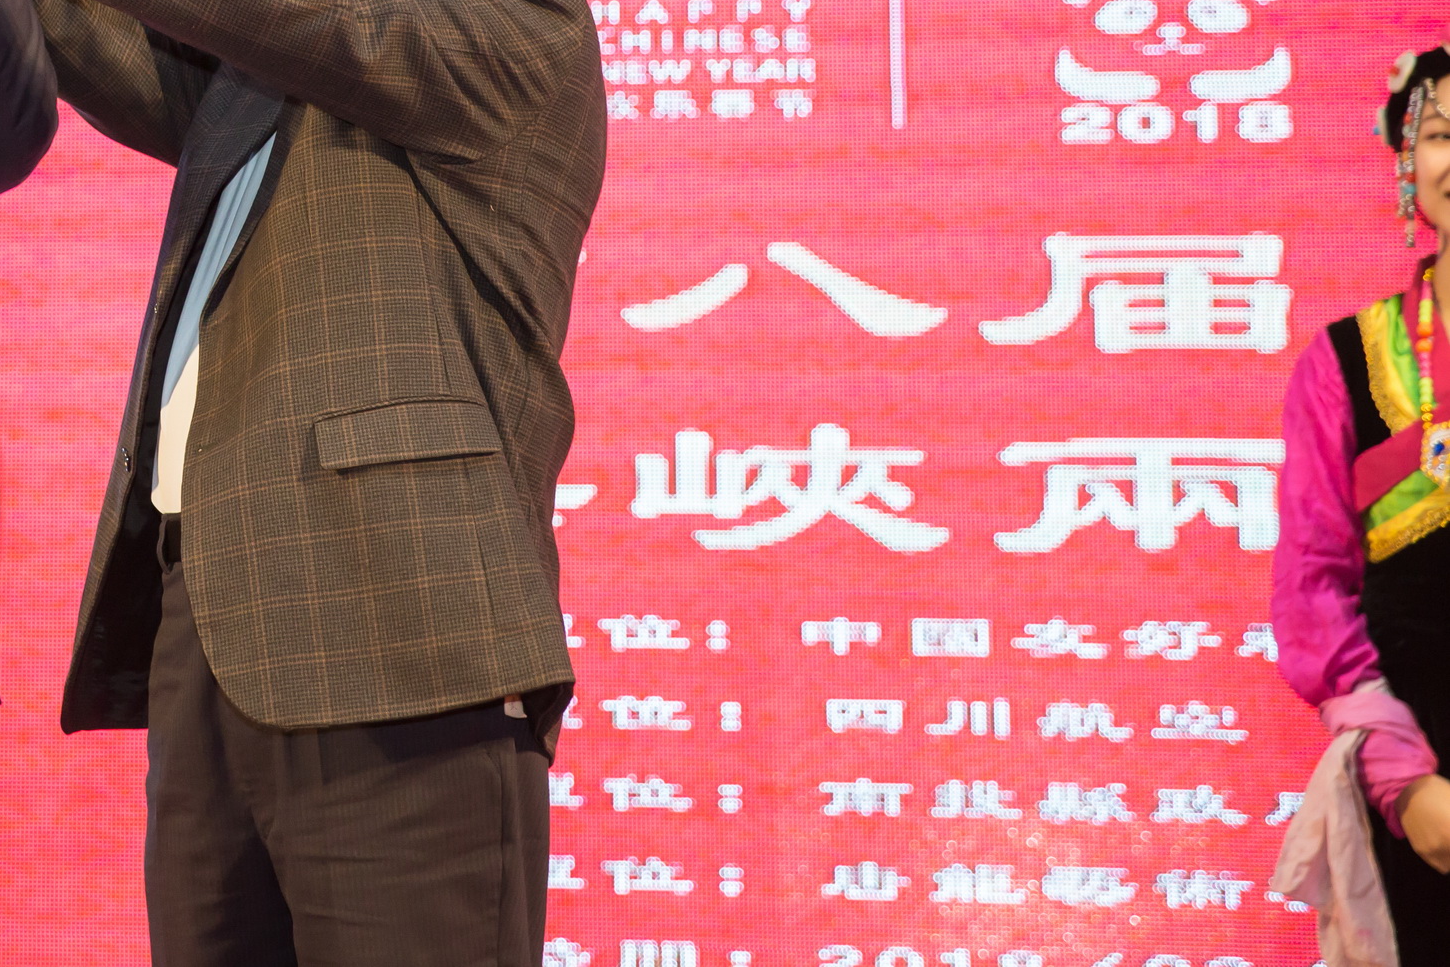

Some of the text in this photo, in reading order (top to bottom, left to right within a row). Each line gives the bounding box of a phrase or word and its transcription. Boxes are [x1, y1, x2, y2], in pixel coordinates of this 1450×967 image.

[598, 25, 811, 54] CHINESE
[602, 57, 817, 83] NEW YEAR
[1060, 104, 1292, 144] 2018
[552, 423, 1286, 552] 峽兩
